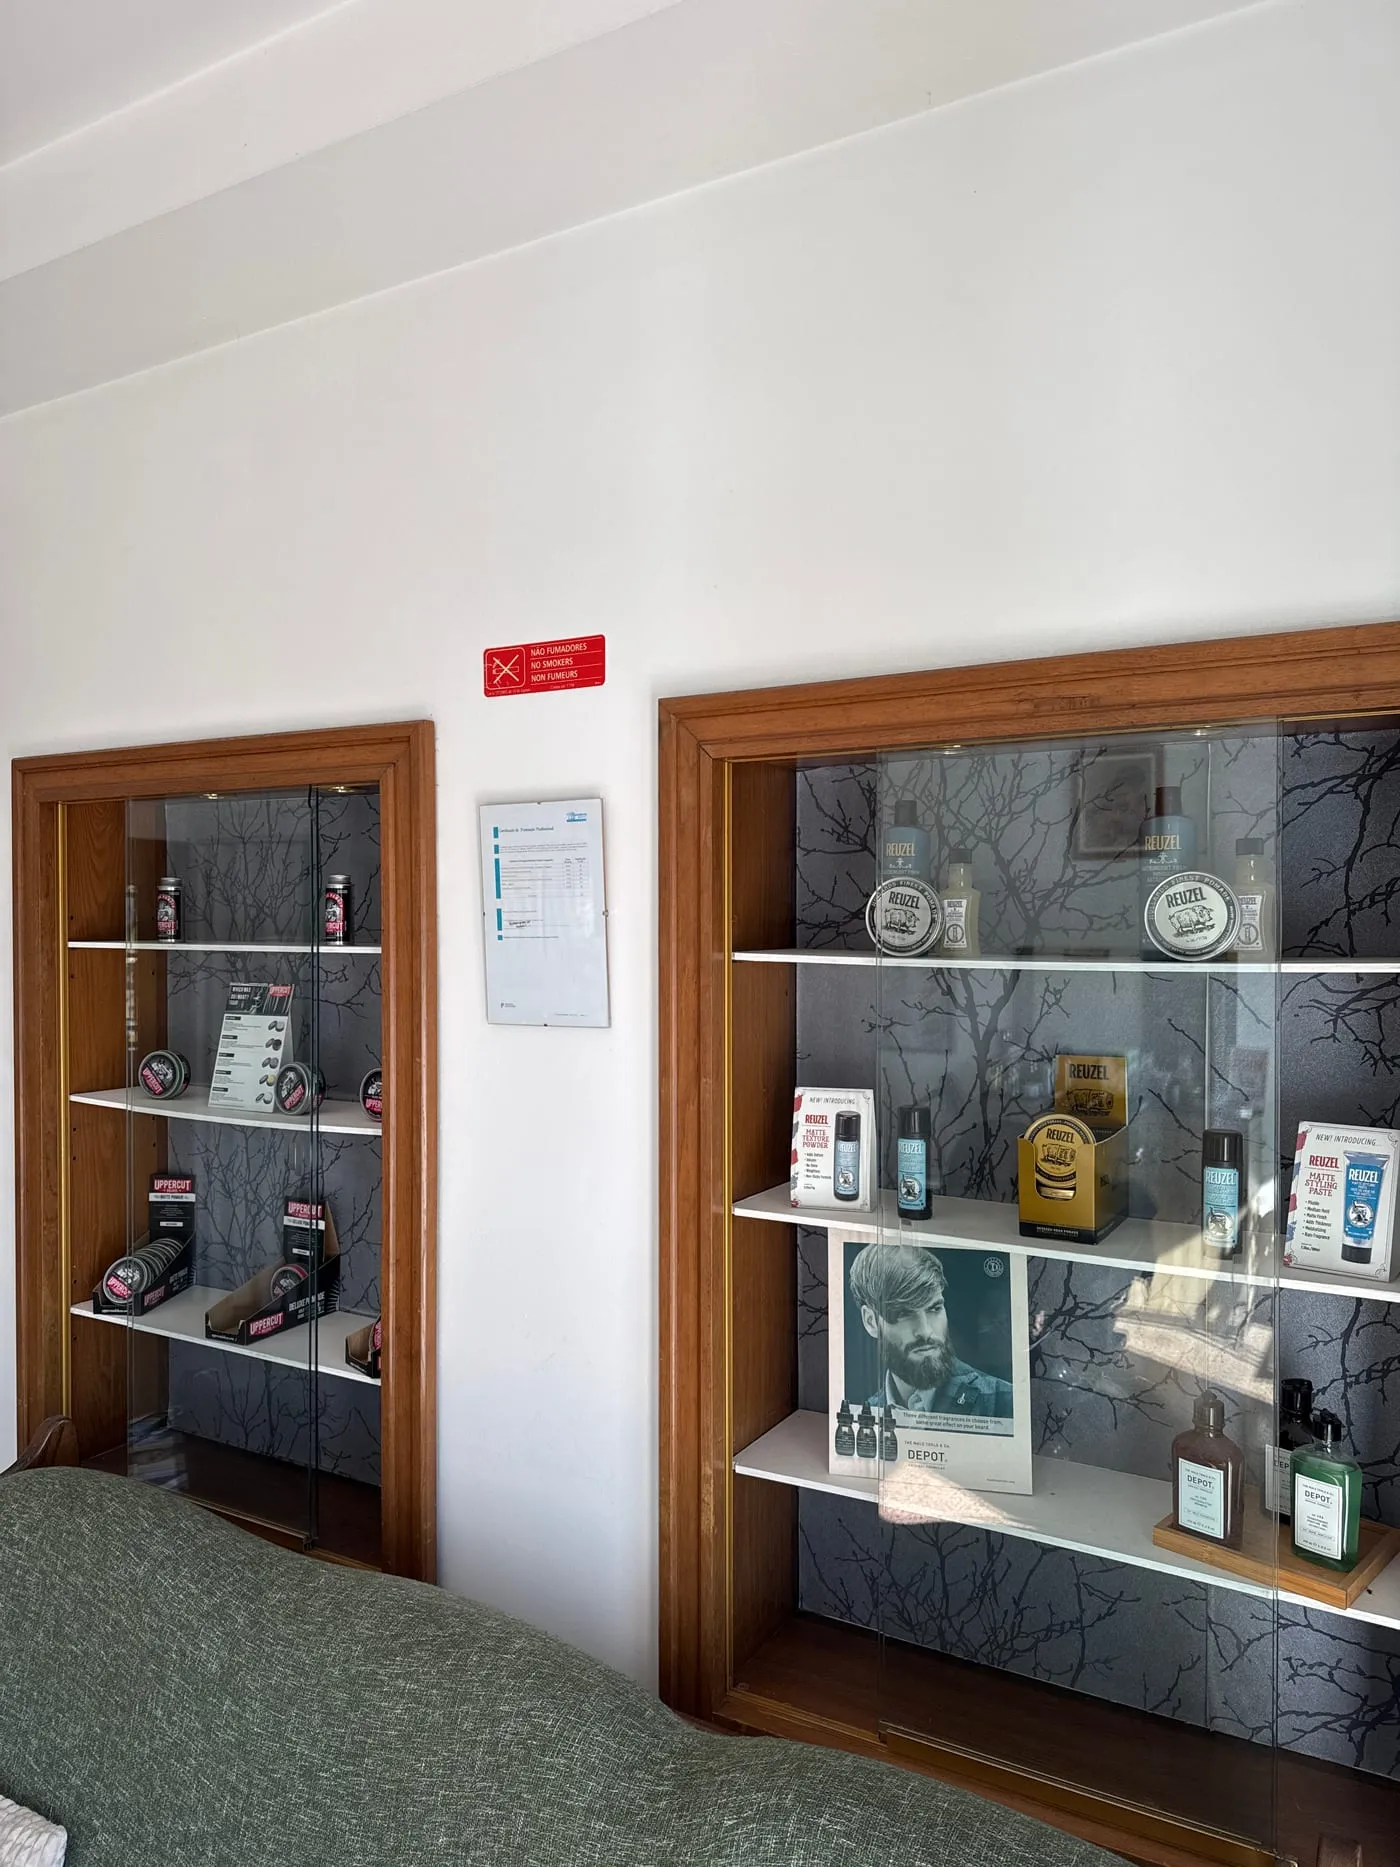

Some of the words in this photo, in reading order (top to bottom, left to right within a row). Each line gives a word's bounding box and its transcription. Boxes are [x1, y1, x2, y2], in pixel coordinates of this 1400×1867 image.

[531, 647, 545, 656] NÃO
[547, 643, 587, 654] FUMADORES
[543, 658, 573, 668] SMOKERS
[532, 674, 546, 682] NON
[548, 670, 578, 681] FUMEURS
[1145, 835, 1182, 850] REUZEL
[886, 843, 916, 856] REUZEL
[1204, 878, 1230, 900] POMADE
[889, 891, 920, 909] REUZEL
[1165, 887, 1206, 908] REUZEL
[1069, 1064, 1109, 1080] REUZEL
[142, 1067, 164, 1095] UPPERCUT
[284, 1083, 304, 1110] UPPERCUT
[805, 1114, 829, 1125] REUZEL
[1047, 1128, 1074, 1144] REUZEL
[1334, 1136, 1376, 1146] INTRODUCING
[899, 1143, 922, 1153] REUZEL
[1309, 1155, 1339, 1168] REUZEL
[1205, 1171, 1235, 1185] REUZEL
[1309, 1172, 1335, 1182] MATTE
[1349, 1169, 1379, 1183] REUZEL
[154, 1179, 191, 1191] UPPERCUT
[1305, 1180, 1337, 1189] STYLING
[1309, 1187, 1332, 1196] PASTE
[107, 1276, 132, 1298] UPPERCUT
[144, 1285, 165, 1306] UPPERCUT
[289, 1299, 304, 1311] DELUXE
[250, 1312, 283, 1336] UPPERCUT
